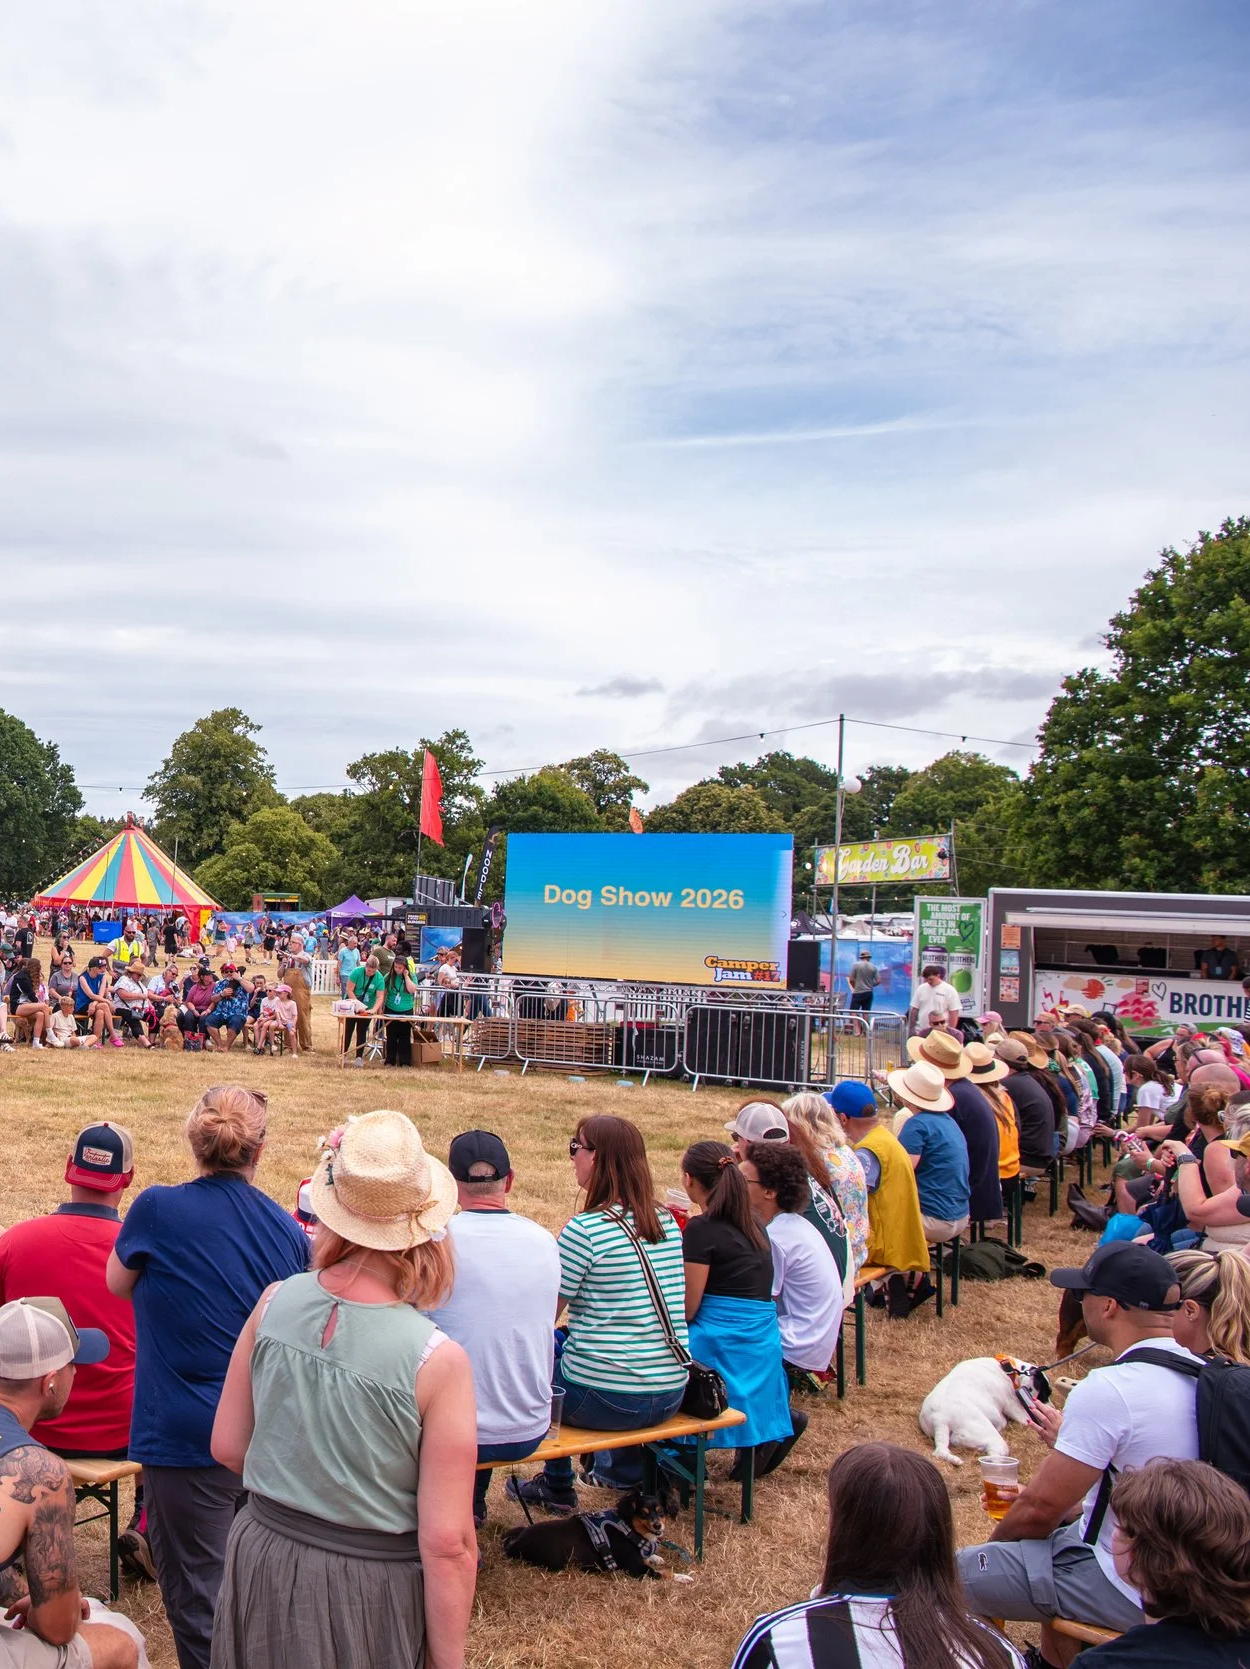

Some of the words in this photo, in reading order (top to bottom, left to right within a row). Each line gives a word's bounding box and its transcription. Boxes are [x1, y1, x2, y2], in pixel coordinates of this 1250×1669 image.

[836, 847, 890, 881] Garden
[890, 844, 928, 874] Bar
[543, 884, 592, 910] Dog
[600, 885, 672, 907] Show
[680, 888, 745, 910] 2026
[926, 903, 940, 912] THE
[941, 904, 960, 912] MOST
[930, 912, 960, 920] AMOUNT
[961, 912, 971, 921] OF
[921, 919, 947, 928] SMILES
[948, 920, 956, 928] IN
[923, 927, 937, 936] ONE
[938, 927, 961, 937] PLACE
[928, 935, 947, 944] EVER
[703, 955, 781, 972] Camper
[713, 966, 753, 982] Jam
[753, 968, 781, 982] #17
[1169, 991, 1247, 1019] BROTH
[636, 1054, 665, 1062] SHAZAM
